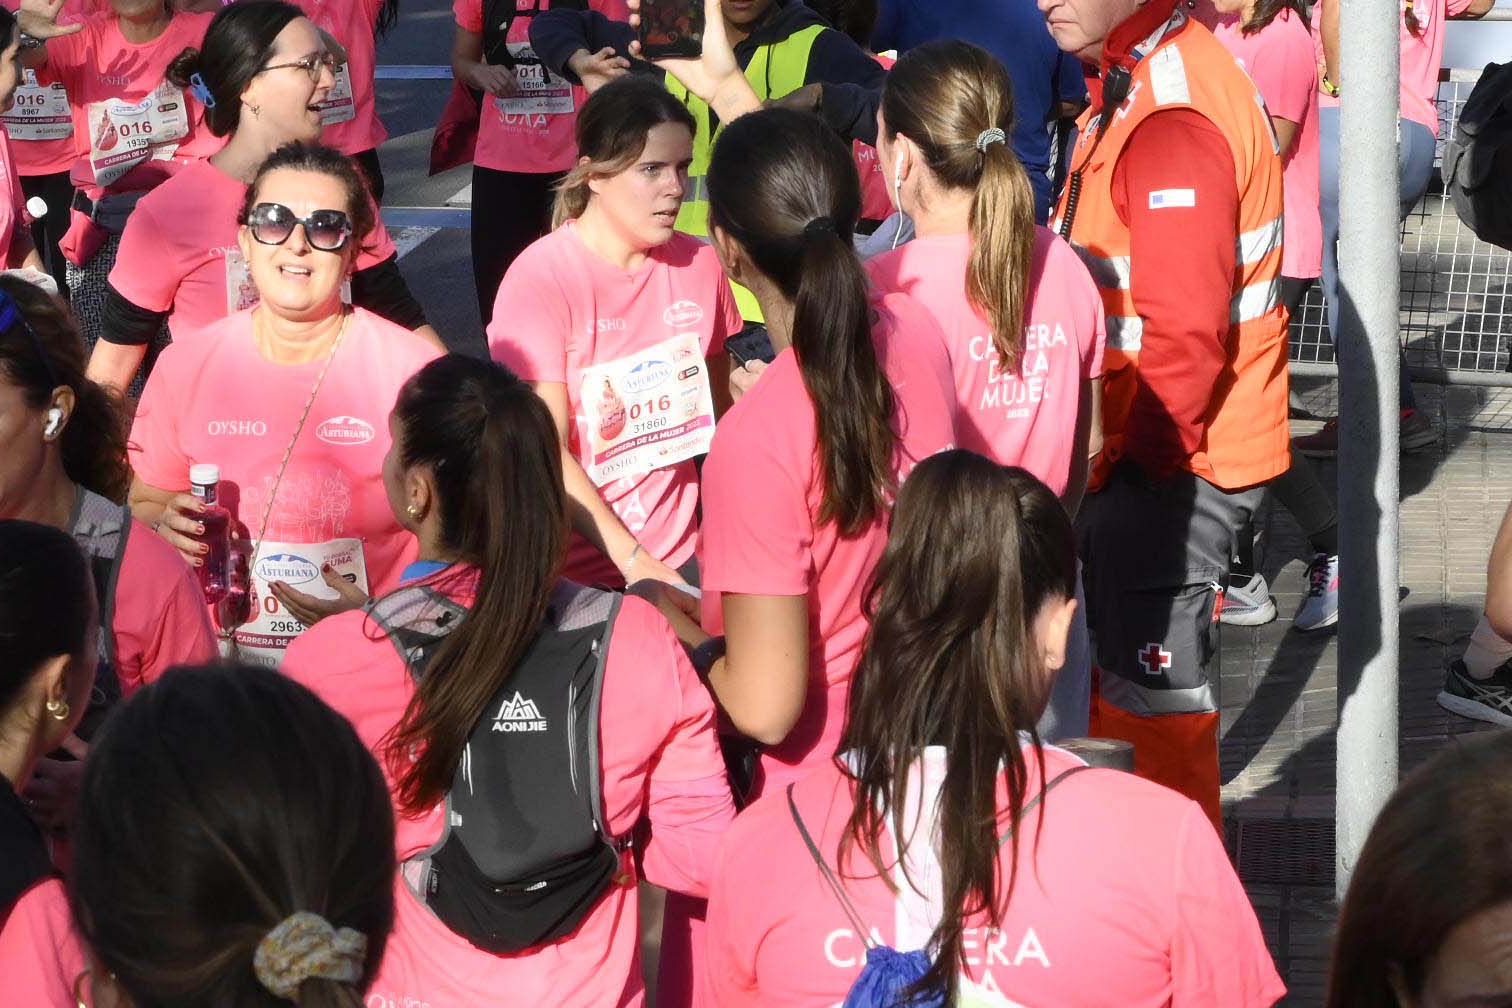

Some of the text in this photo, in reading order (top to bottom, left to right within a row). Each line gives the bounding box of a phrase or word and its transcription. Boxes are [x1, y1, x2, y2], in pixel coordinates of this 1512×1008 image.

[17, 94, 45, 106] 016
[22, 108, 39, 116] 8967
[119, 121, 152, 137] 016
[104, 152, 132, 166] CARRERA
[968, 322, 1067, 361] CAERA
[629, 395, 671, 419] 016
[208, 419, 267, 436] OYSHO
[321, 424, 371, 440] ASTURIANA
[633, 416, 667, 434] 31860
[605, 439, 635, 458] CARRERA
[637, 437, 647, 446] DE
[648, 433, 659, 442] LA
[660, 427, 685, 440] MUJER
[259, 564, 314, 577] ASTURIANA
[270, 621, 306, 632] 2963
[236, 635, 274, 646] CARRERA
[492, 720, 547, 731] AONIJIE
[824, 927, 1051, 968] CAERA
